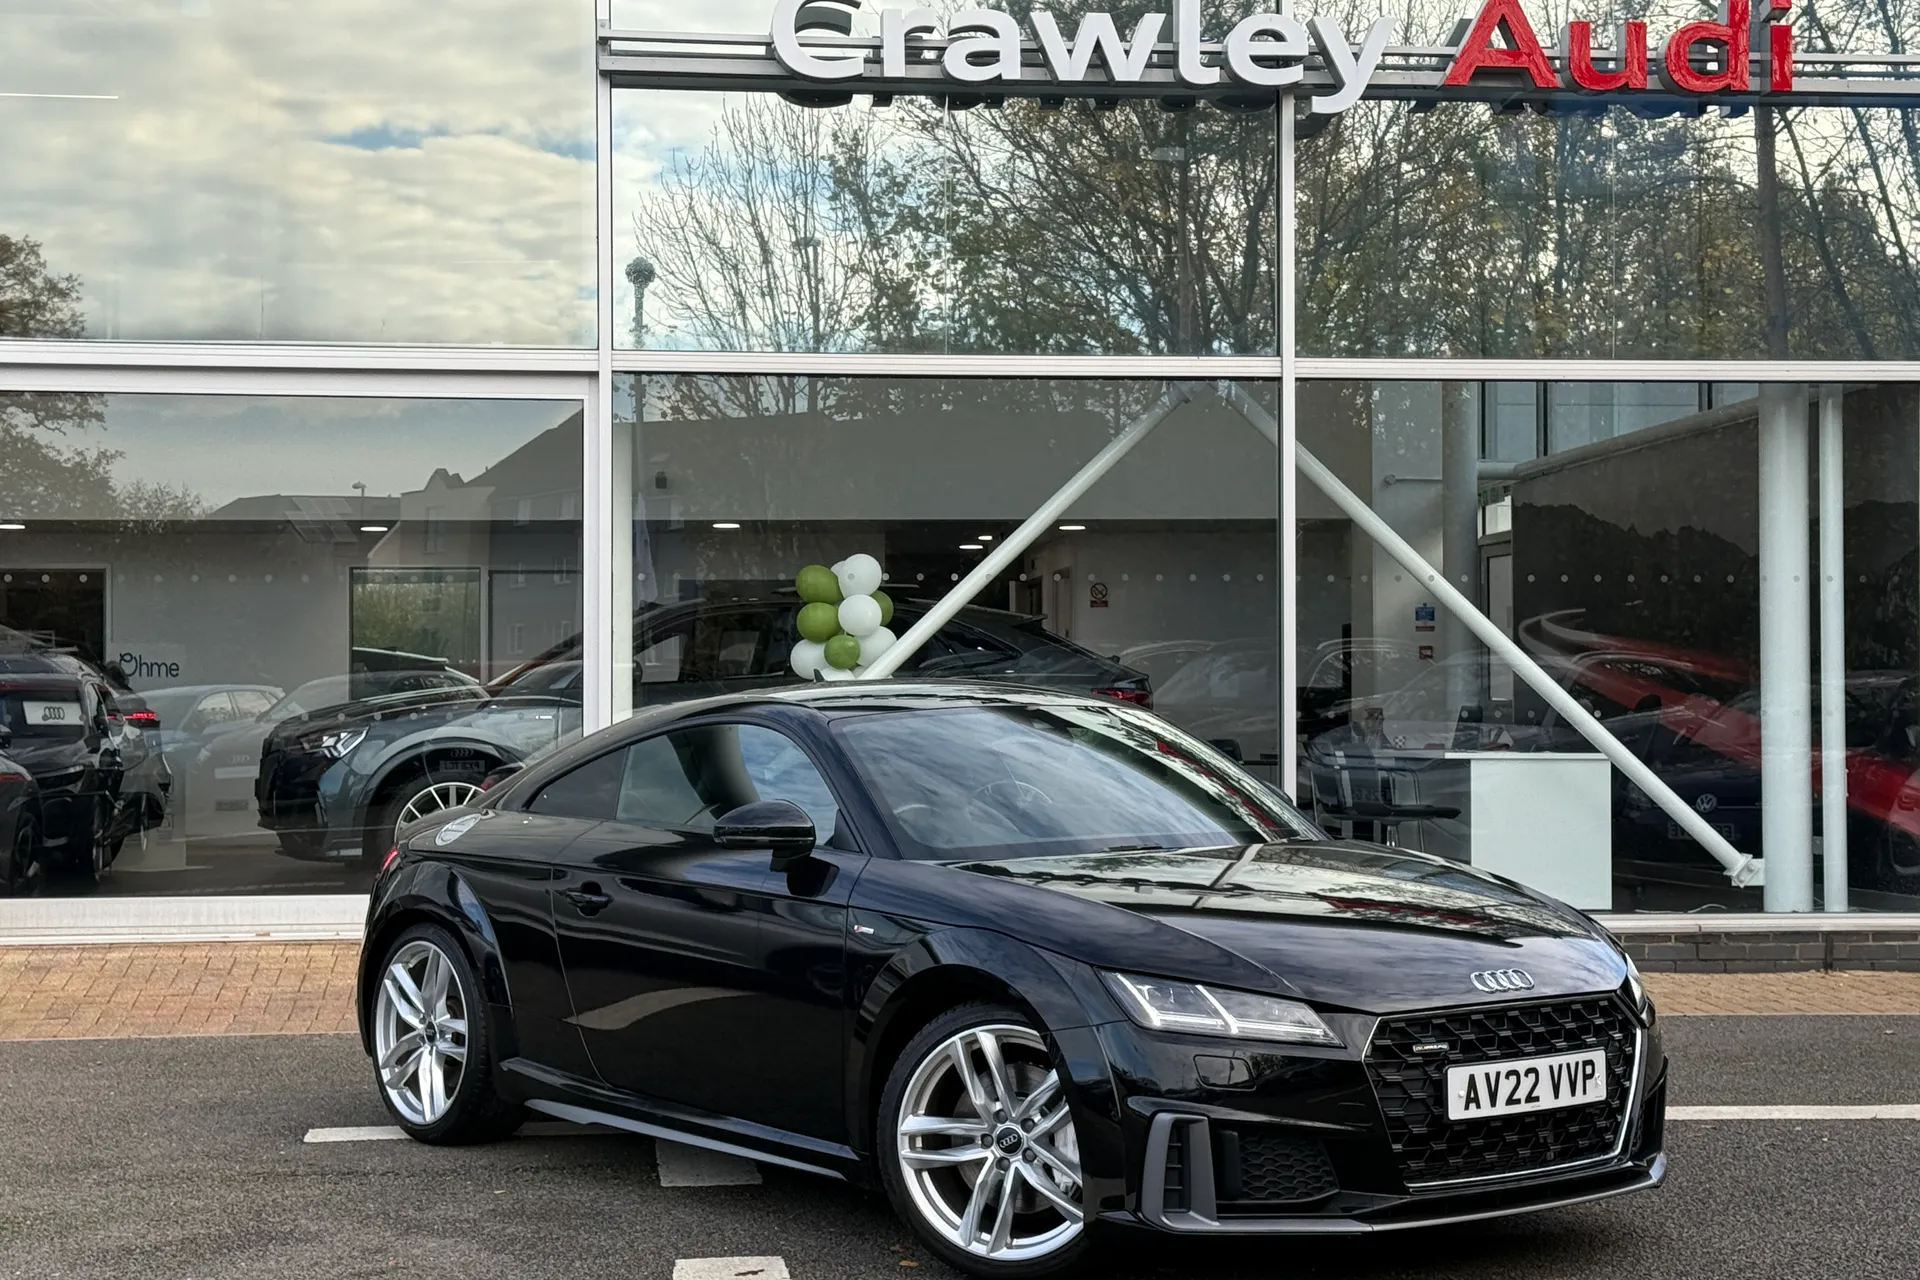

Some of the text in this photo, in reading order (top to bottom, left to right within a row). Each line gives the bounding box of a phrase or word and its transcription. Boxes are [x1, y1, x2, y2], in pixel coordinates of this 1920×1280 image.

[770, 0, 1793, 114] Crawley Audi
[119, 652, 180, 678] Ohme
[1463, 1059, 1596, 1111] AV22 VVP
